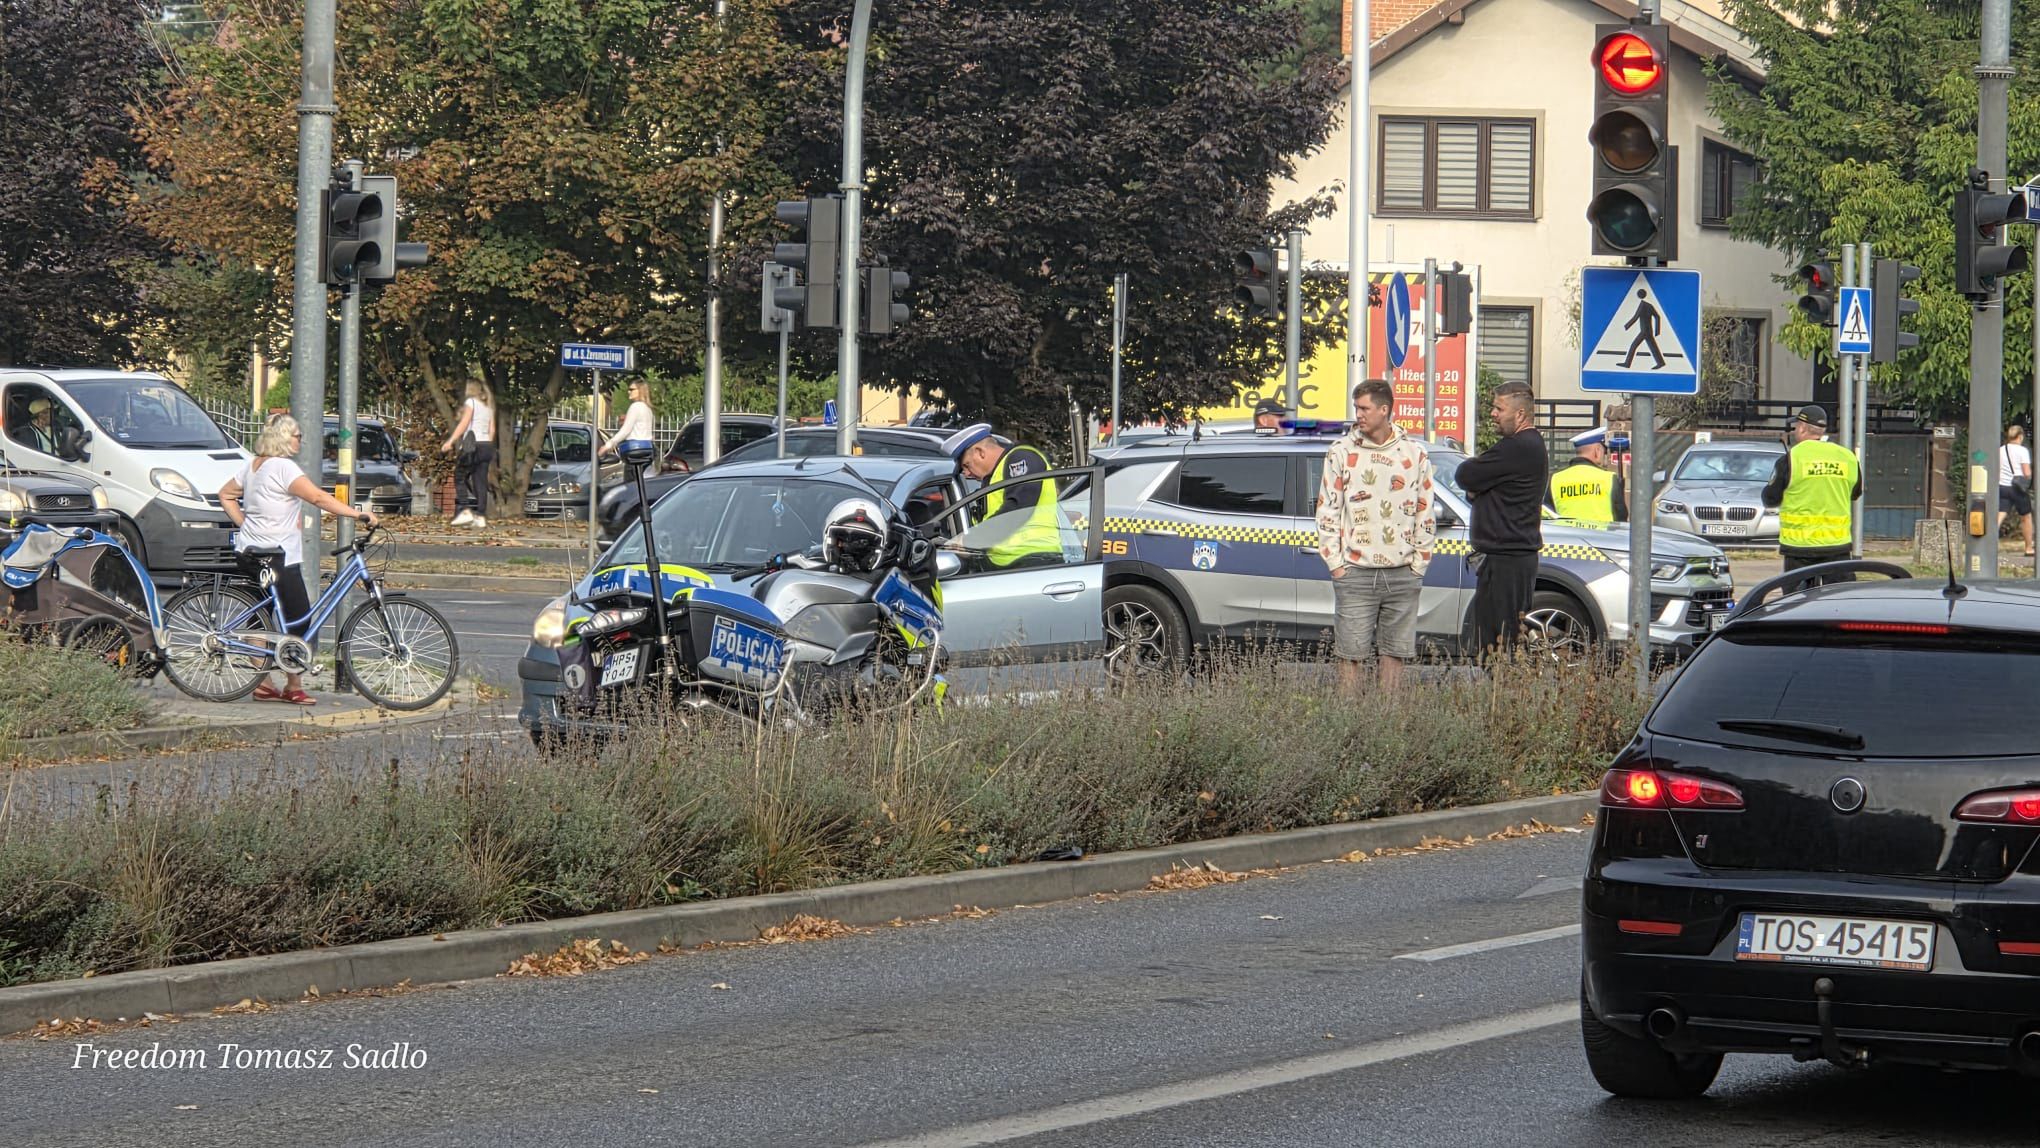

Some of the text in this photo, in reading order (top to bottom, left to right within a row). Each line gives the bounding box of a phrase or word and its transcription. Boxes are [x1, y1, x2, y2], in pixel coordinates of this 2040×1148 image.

[1444, 370, 1459, 381] 20
[1395, 384, 1414, 394] 536
[1439, 385, 1458, 395] 236
[1442, 405, 1459, 417] 26
[1438, 421, 1457, 430] 236
[1560, 483, 1602, 499] POLICJA
[715, 628, 776, 669] POLICJA
[613, 653, 632, 667] HPS
[1738, 938, 1751, 948] PL
[1757, 917, 1929, 961] TOS 45415
